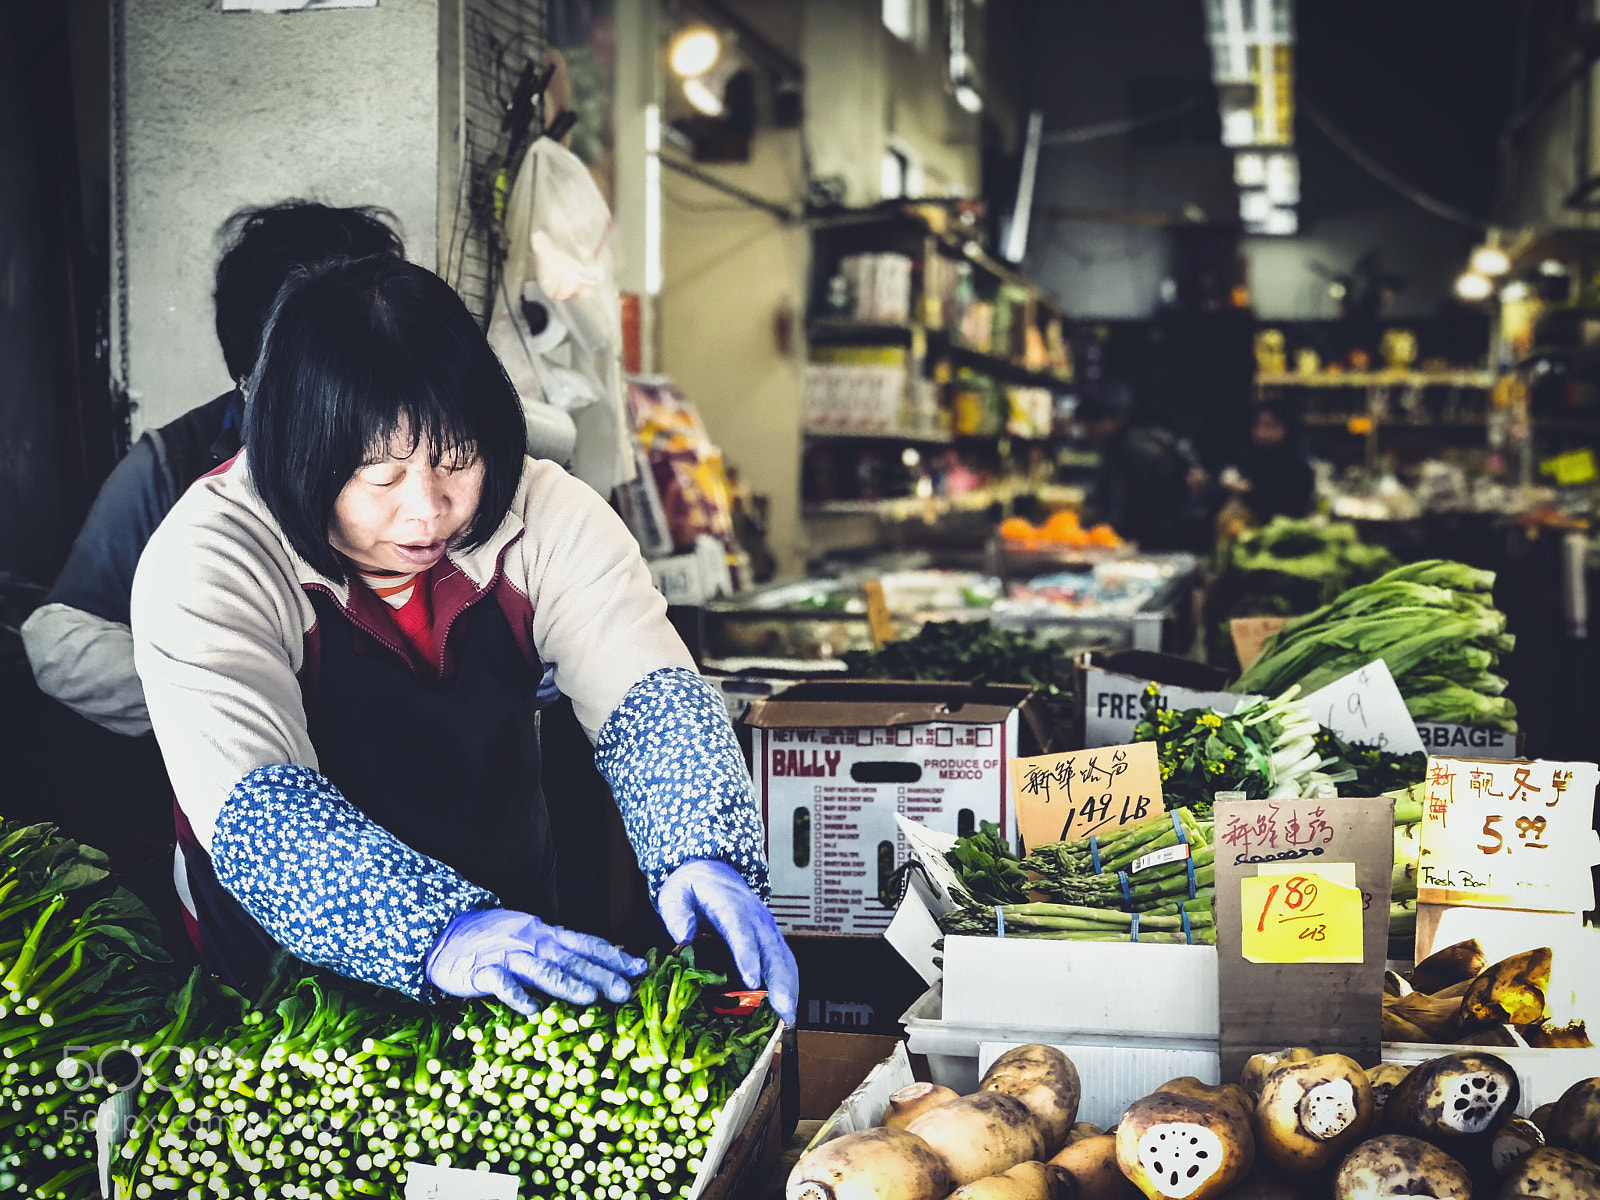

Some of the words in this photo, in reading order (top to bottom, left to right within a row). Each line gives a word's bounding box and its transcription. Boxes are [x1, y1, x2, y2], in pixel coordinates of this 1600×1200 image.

[772, 749, 841, 777] BALLY
[924, 760, 979, 769] PRODUCE
[983, 760, 999, 769] OF
[939, 770, 983, 780] MEXICO
[1119, 795, 1151, 826] LB
